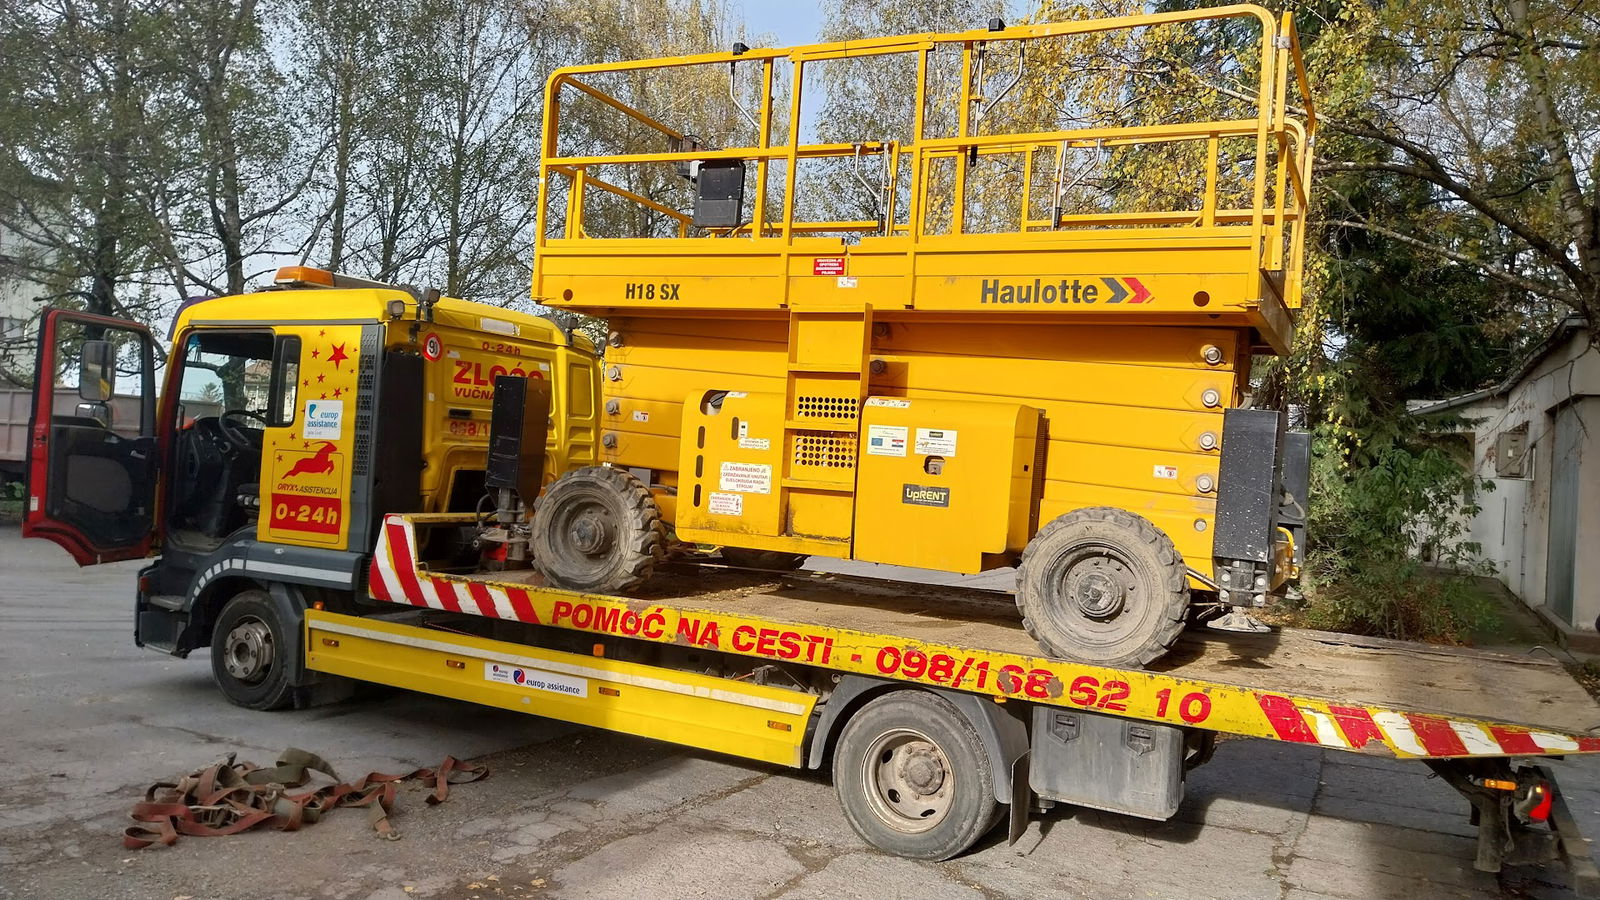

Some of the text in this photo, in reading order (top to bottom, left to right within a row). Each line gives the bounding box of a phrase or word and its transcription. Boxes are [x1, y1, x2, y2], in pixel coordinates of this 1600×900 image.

[625, 283, 680, 300] H18 SX
[980, 278, 1099, 304] Haulotte
[320, 411, 339, 420] europ
[307, 419, 338, 428] assistance
[729, 465, 760, 473] ZABRANJENO
[299, 485, 338, 495] ASISTENCIJA
[906, 487, 947, 501] UpRENT
[275, 503, 338, 525] 0-24h
[551, 600, 666, 639] POMOĆ
[677, 617, 720, 648] NA
[732, 625, 834, 665] CESTI
[1069, 675, 1131, 711] 62
[1155, 688, 1212, 724] 10
[526, 678, 580, 694] europ assistance
